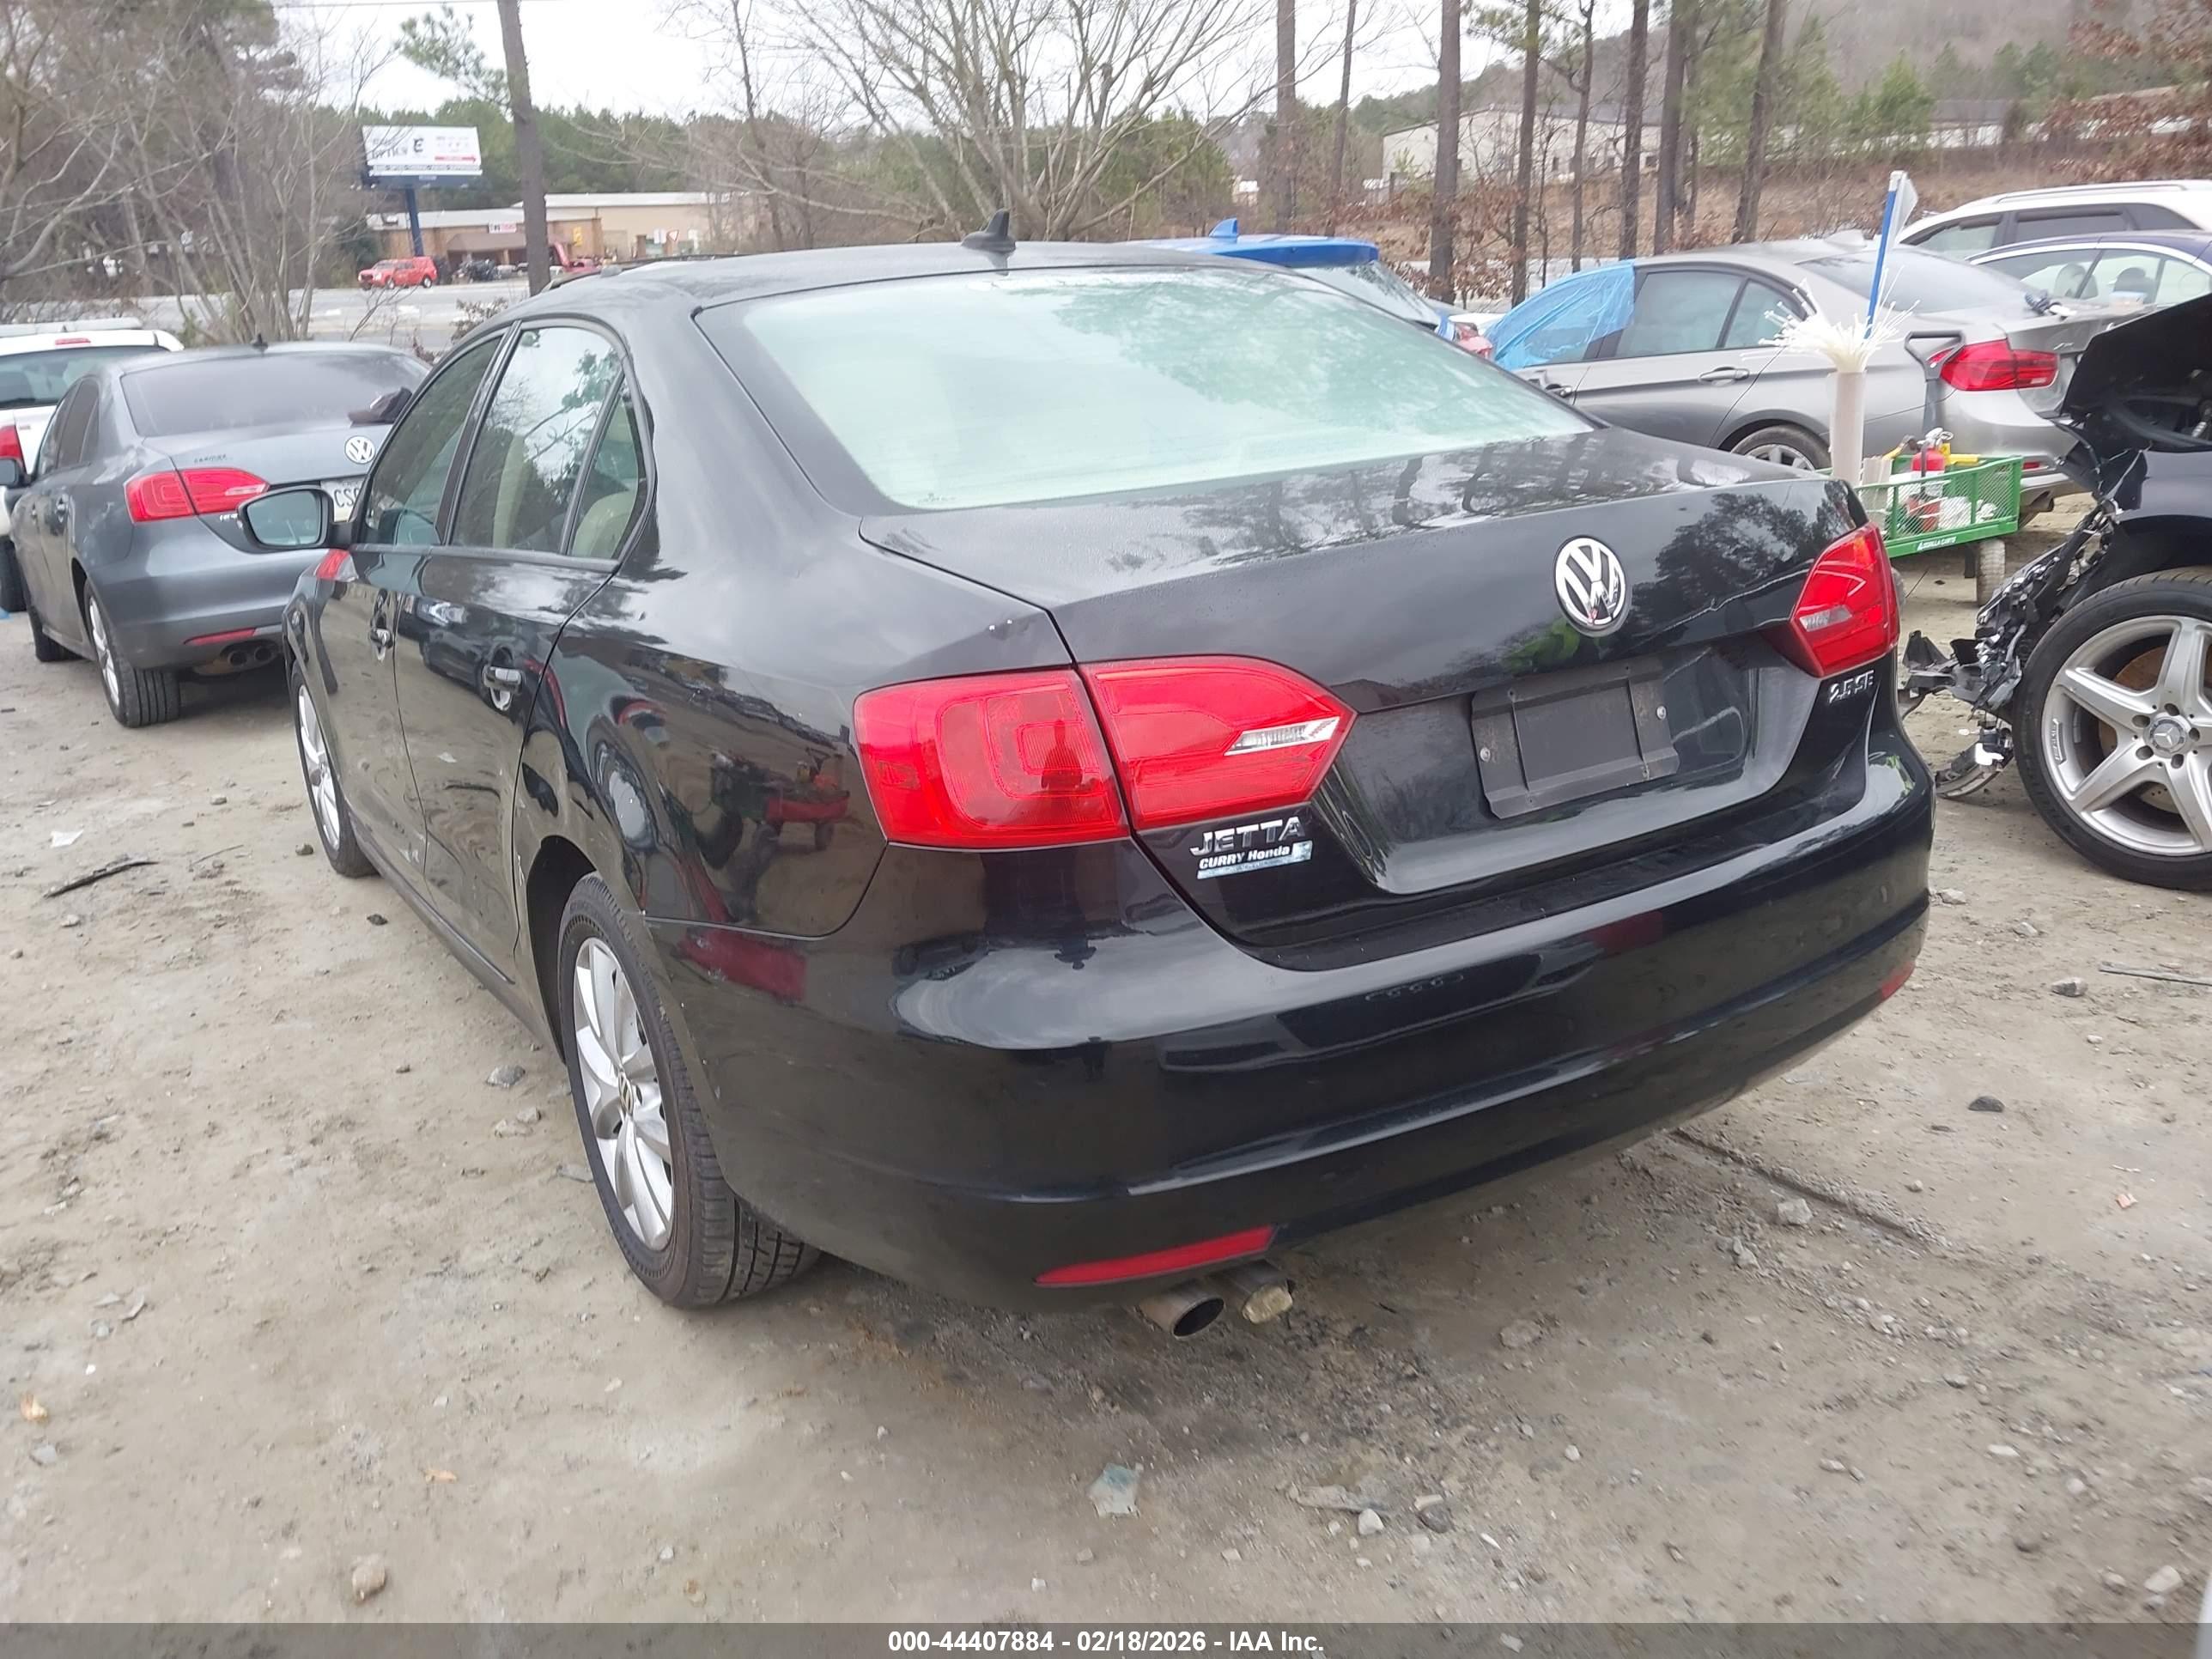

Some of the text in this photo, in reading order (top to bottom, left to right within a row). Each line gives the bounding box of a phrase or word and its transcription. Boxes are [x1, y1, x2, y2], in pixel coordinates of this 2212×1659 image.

[1189, 816, 1306, 856] JETTA
[1199, 852, 1245, 870] CURRY
[1248, 845, 1291, 861] Honda
